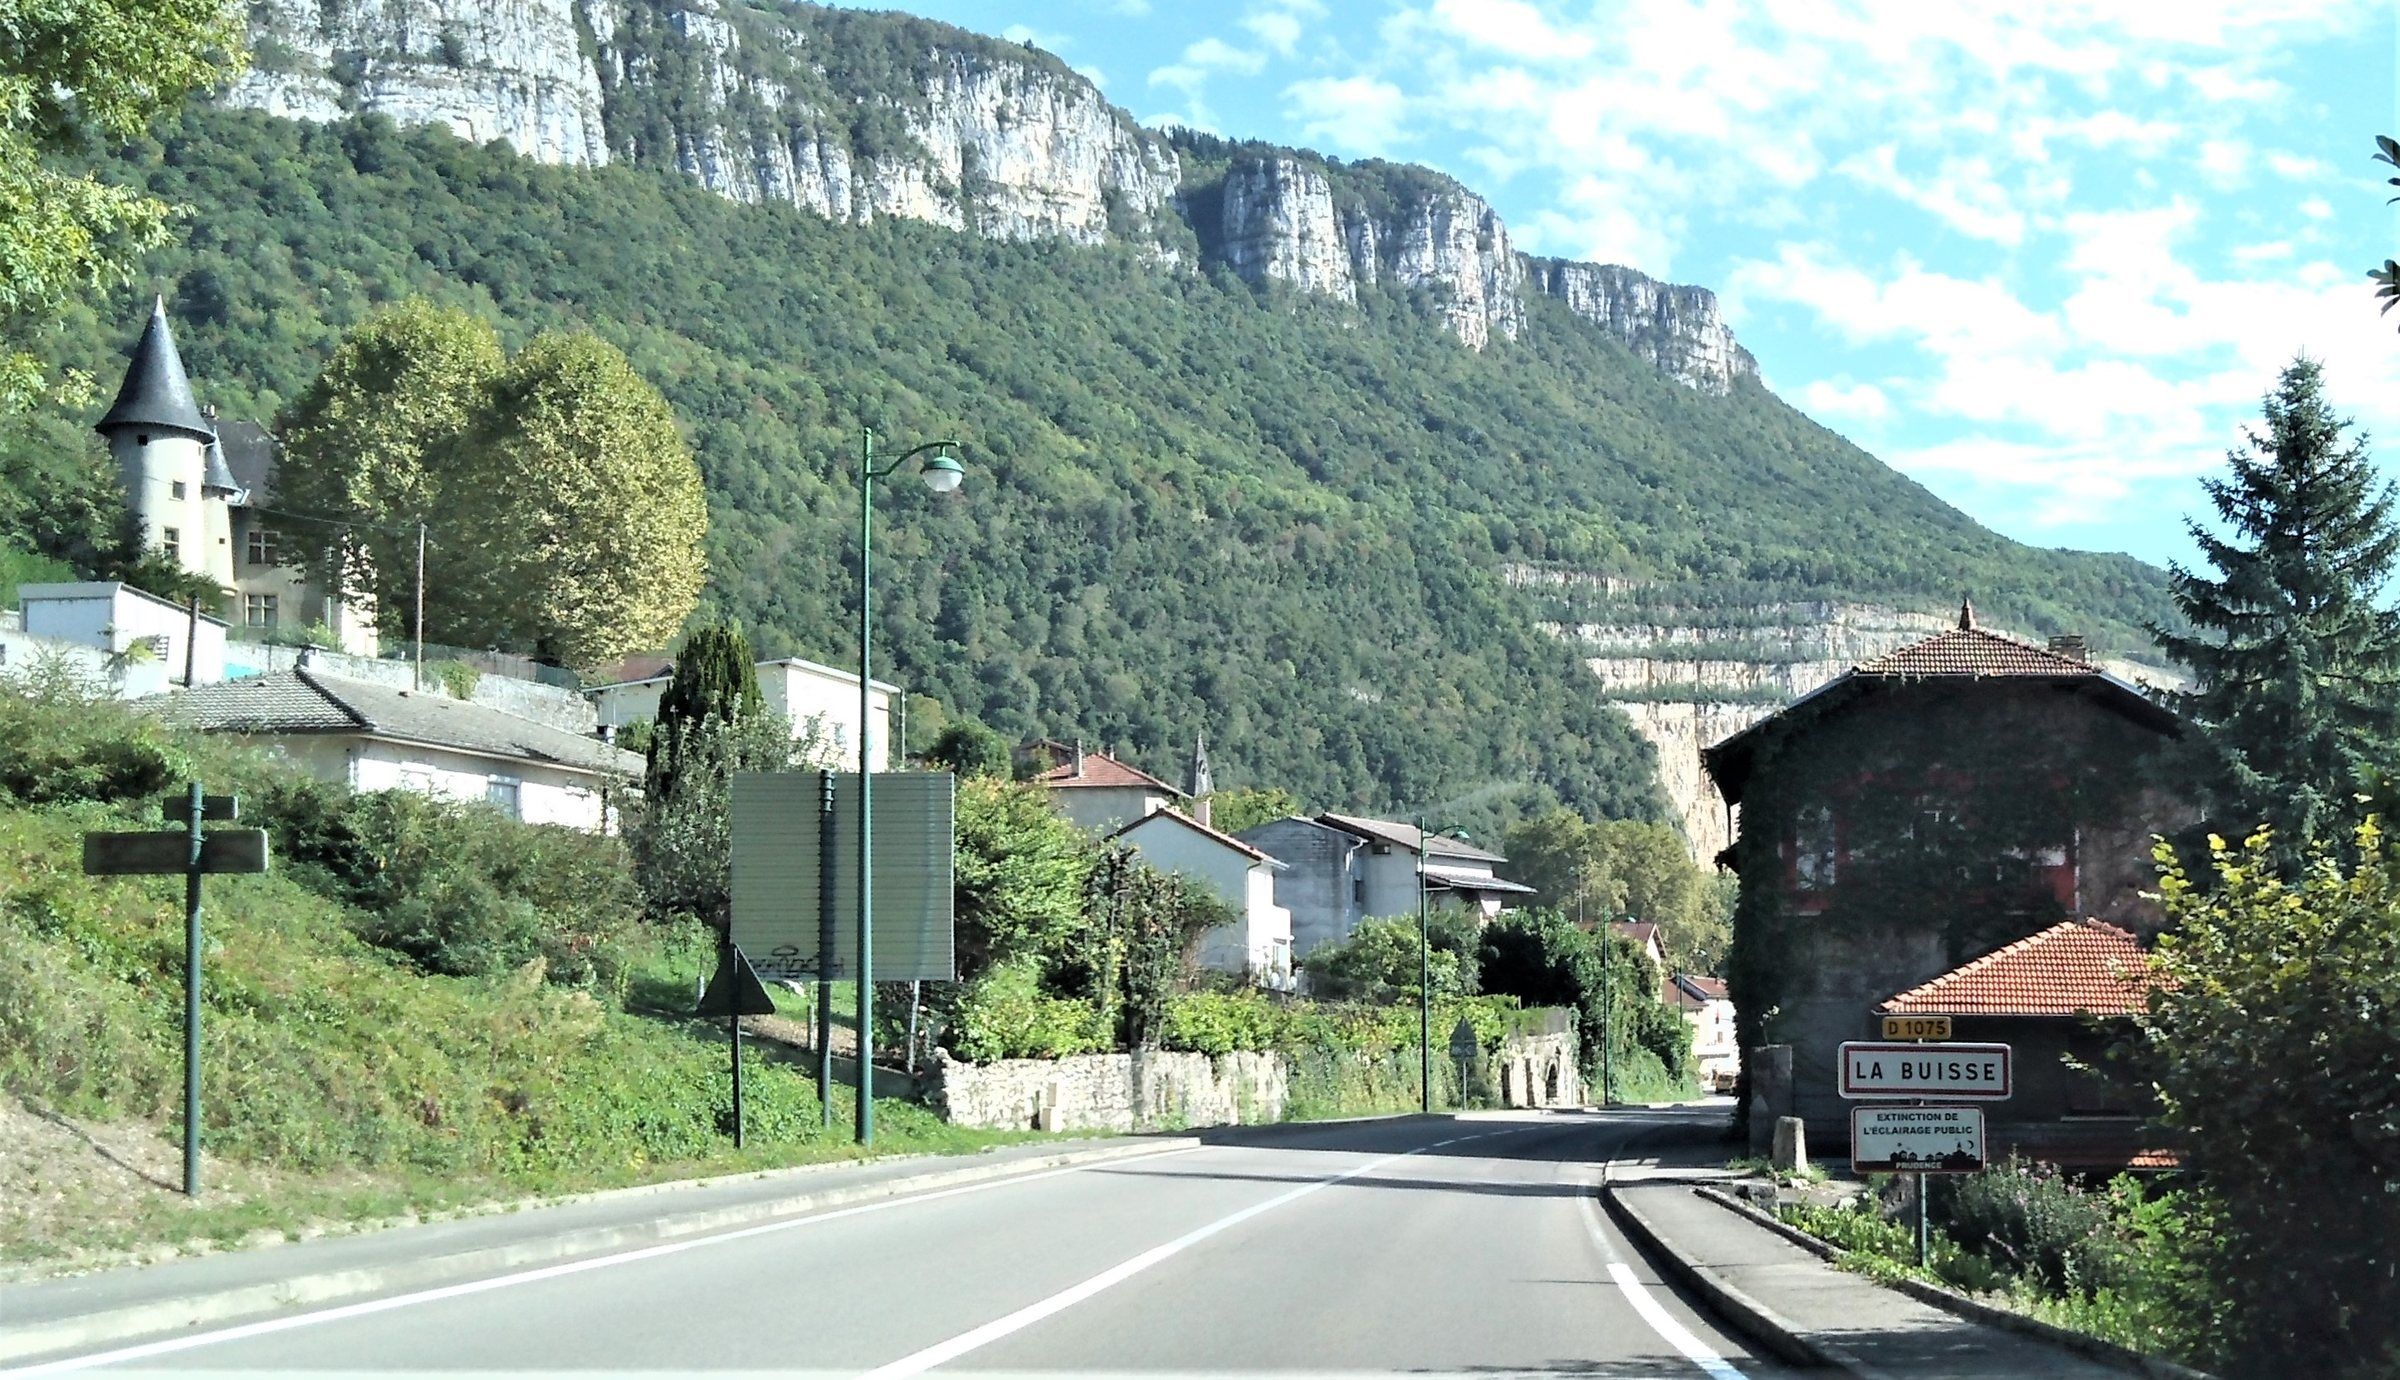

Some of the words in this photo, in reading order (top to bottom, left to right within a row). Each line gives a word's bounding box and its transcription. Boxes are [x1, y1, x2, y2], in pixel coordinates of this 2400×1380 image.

[1888, 1021, 1898, 1035] D
[1905, 1021, 1946, 1035] 1075
[1856, 1061, 1883, 1080] LA
[1902, 1062, 1995, 1081] BUISSE
[1877, 1113, 1941, 1121] EXTINCTION
[1945, 1113, 1959, 1121] DE
[1934, 1126, 1973, 1134] PUBLIC
